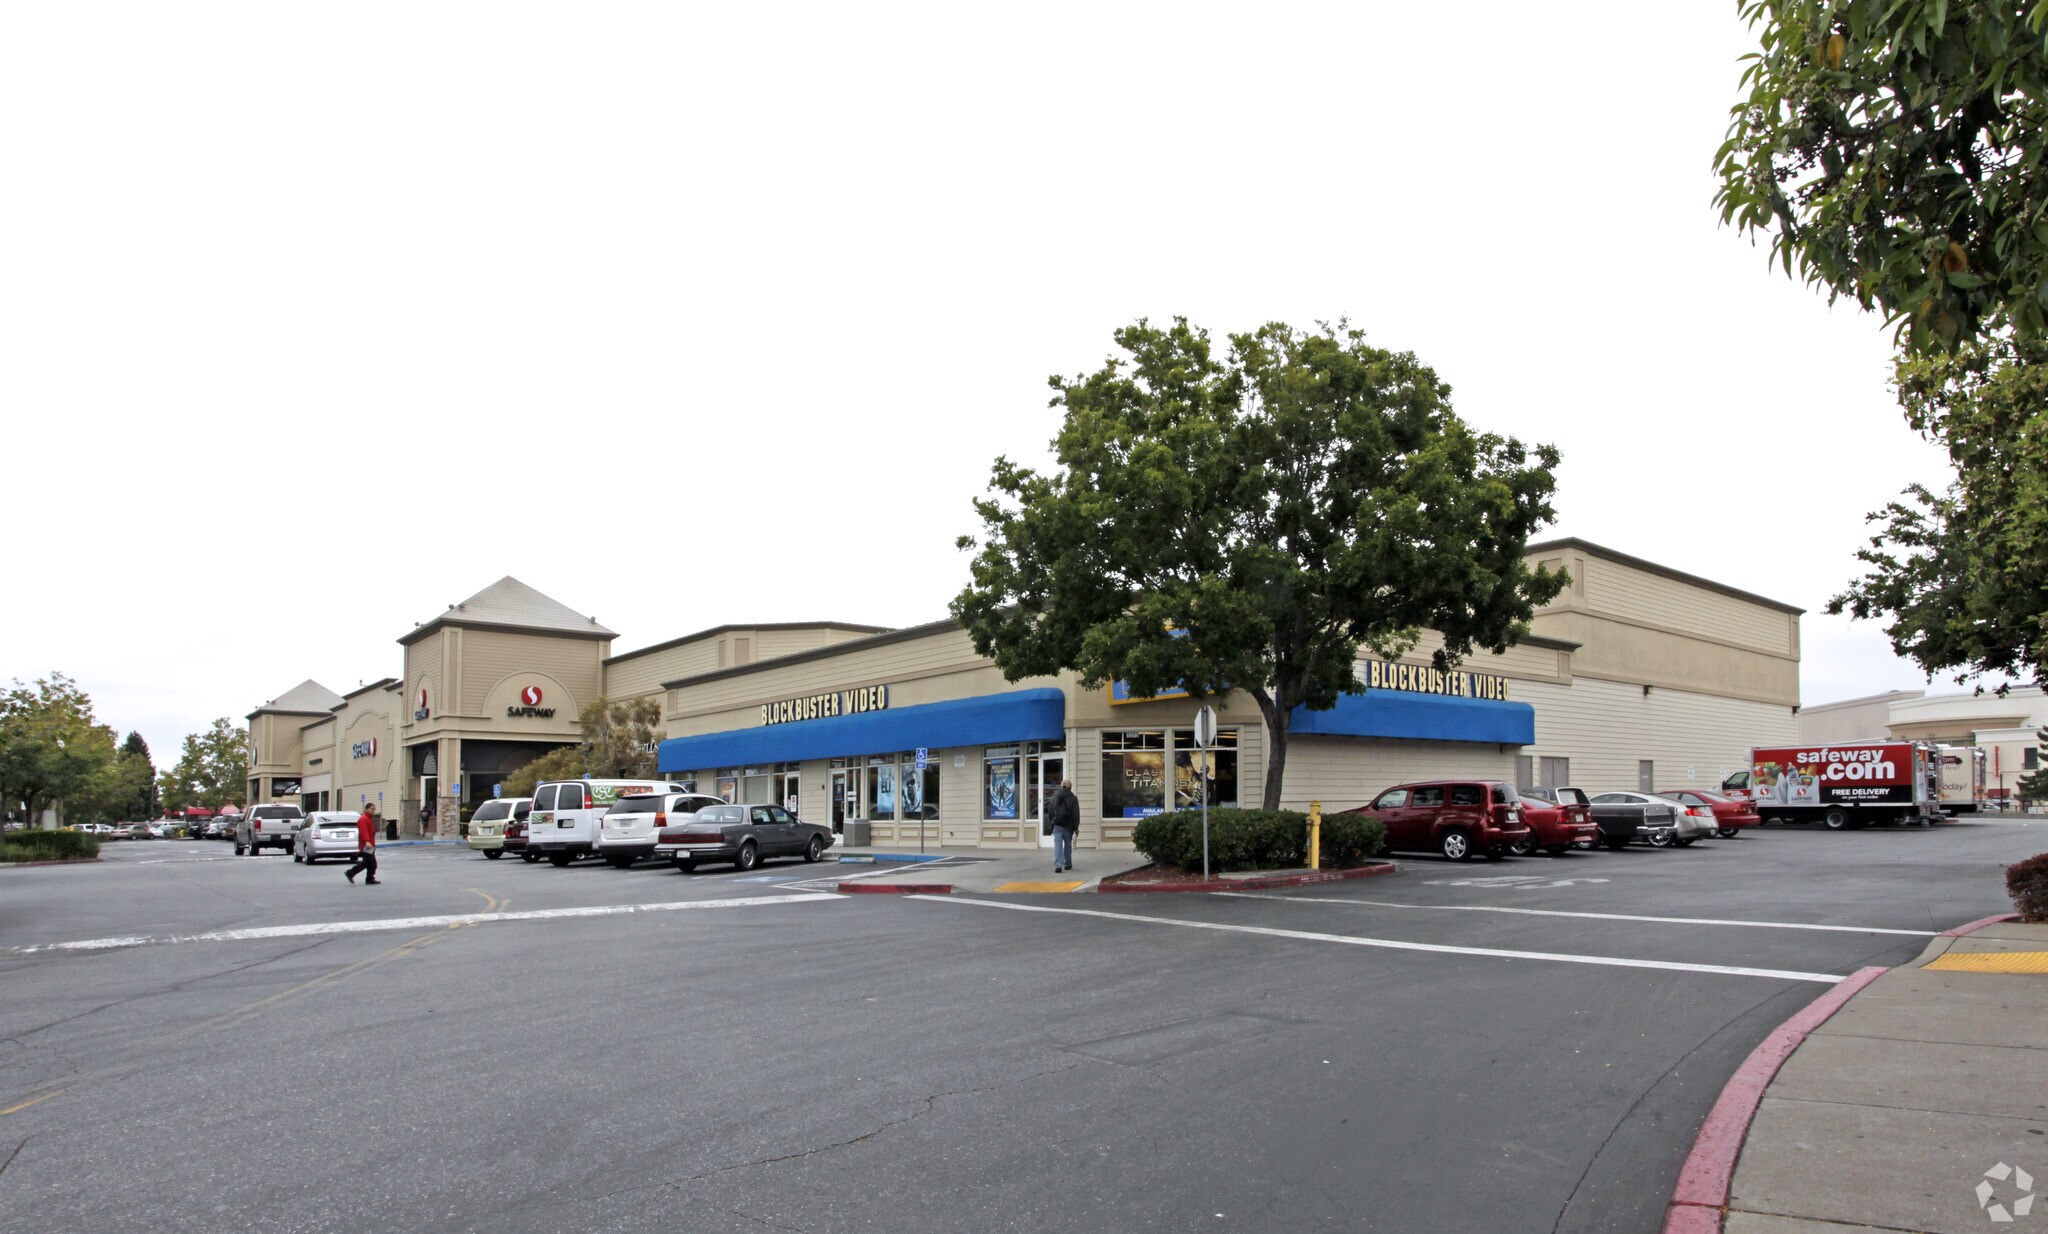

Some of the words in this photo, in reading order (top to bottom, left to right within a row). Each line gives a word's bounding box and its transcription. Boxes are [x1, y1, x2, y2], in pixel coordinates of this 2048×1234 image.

[1370, 660, 1468, 697] BLOCKBUSTER
[1473, 673, 1511, 701] VIDEO
[507, 706, 556, 718] SAFEWAY
[761, 692, 840, 726] BLOCKBUSTER
[845, 684, 887, 713] VIDEO
[1796, 748, 1884, 764] safeway
[1820, 761, 1896, 781] .com
[1852, 788, 1890, 796] DELIVERY
